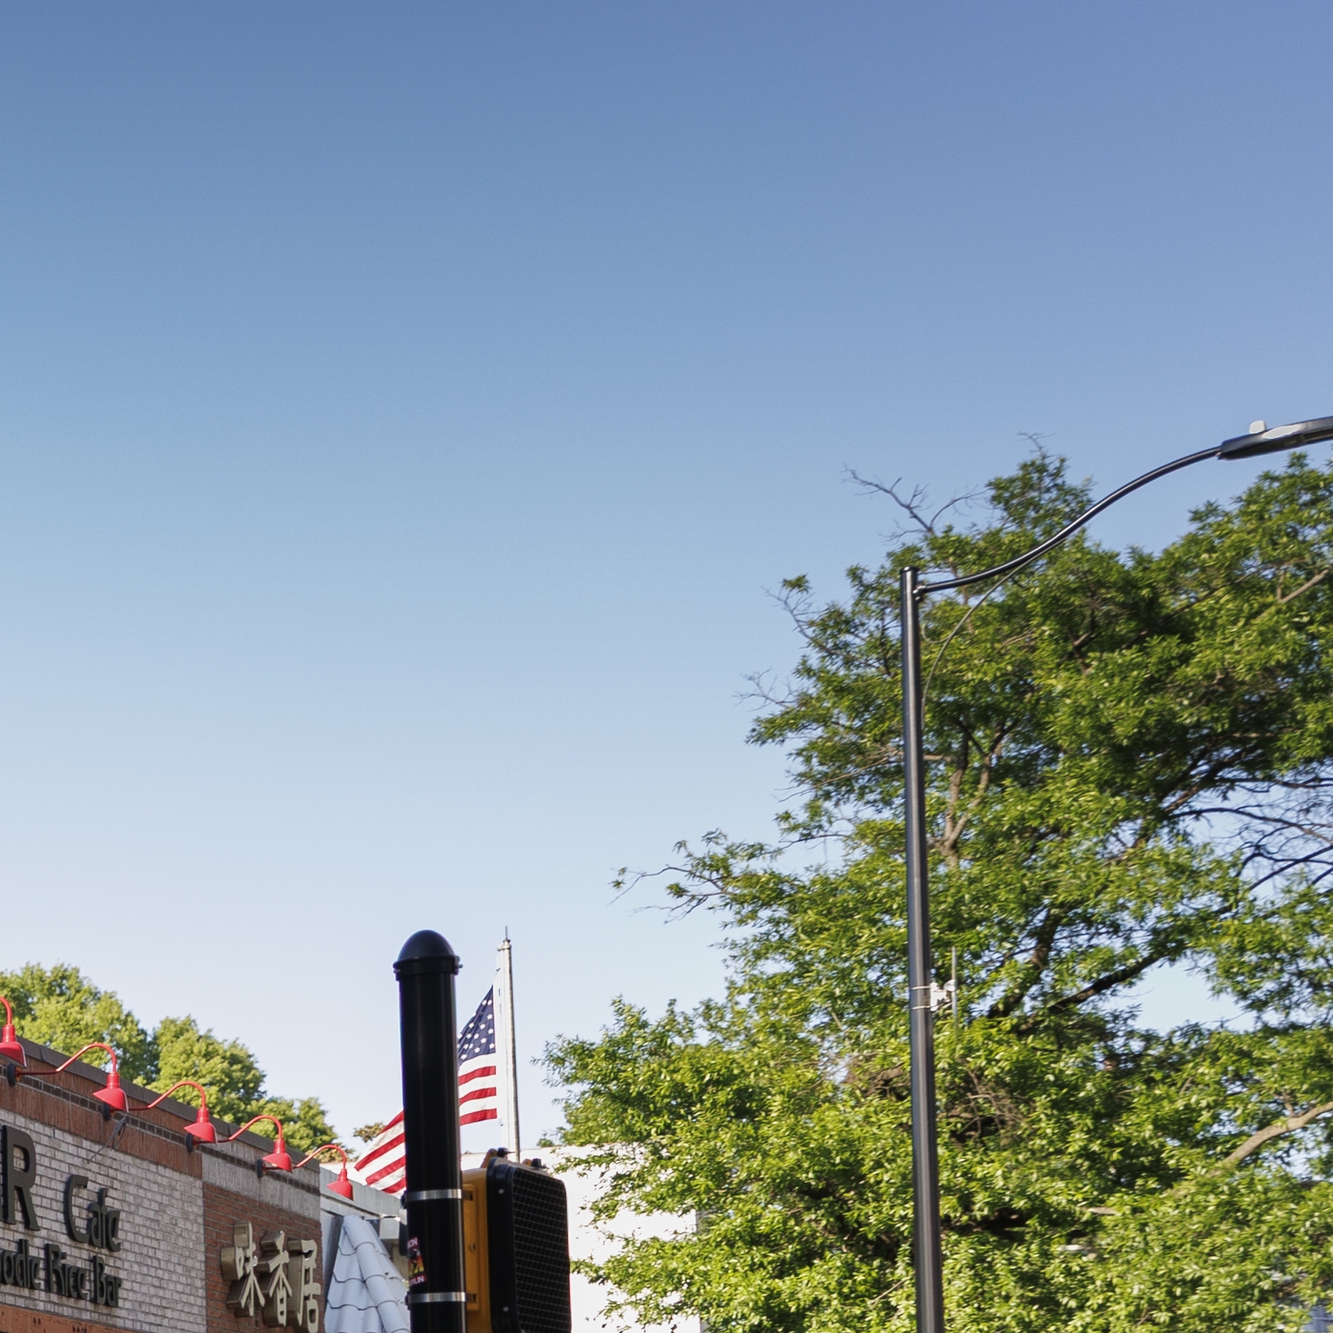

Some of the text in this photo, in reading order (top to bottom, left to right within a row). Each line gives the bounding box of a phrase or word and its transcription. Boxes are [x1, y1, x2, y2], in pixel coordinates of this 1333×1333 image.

[44, 1243, 88, 1300] Rice
[90, 1254, 122, 1308] Bar
[221, 1221, 321, 1333] 味香居
